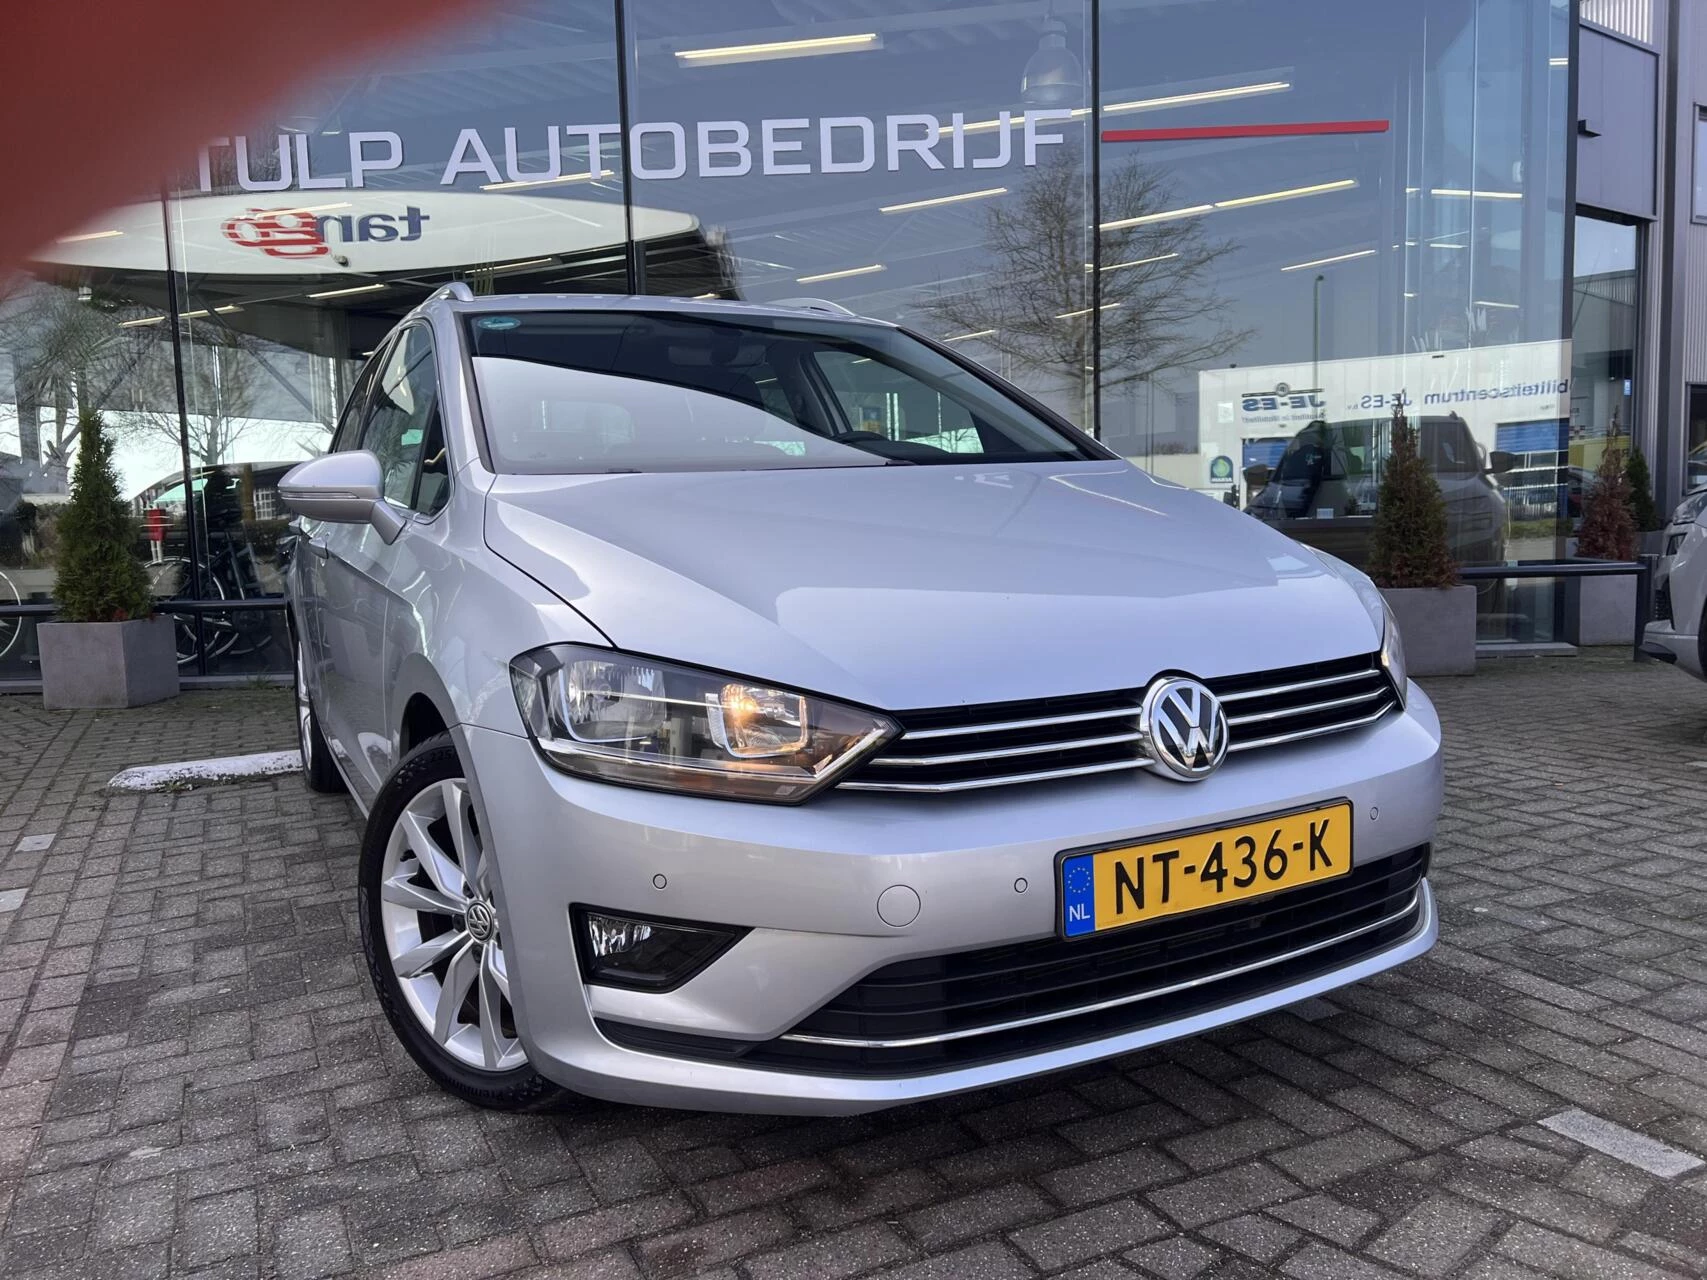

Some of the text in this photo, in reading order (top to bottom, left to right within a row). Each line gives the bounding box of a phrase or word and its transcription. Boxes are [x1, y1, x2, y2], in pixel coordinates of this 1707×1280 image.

[440, 108, 1072, 185] AUTOBEDRIJF
[1115, 819, 1332, 914] NT-436-K
[1069, 904, 1090, 922] NL
